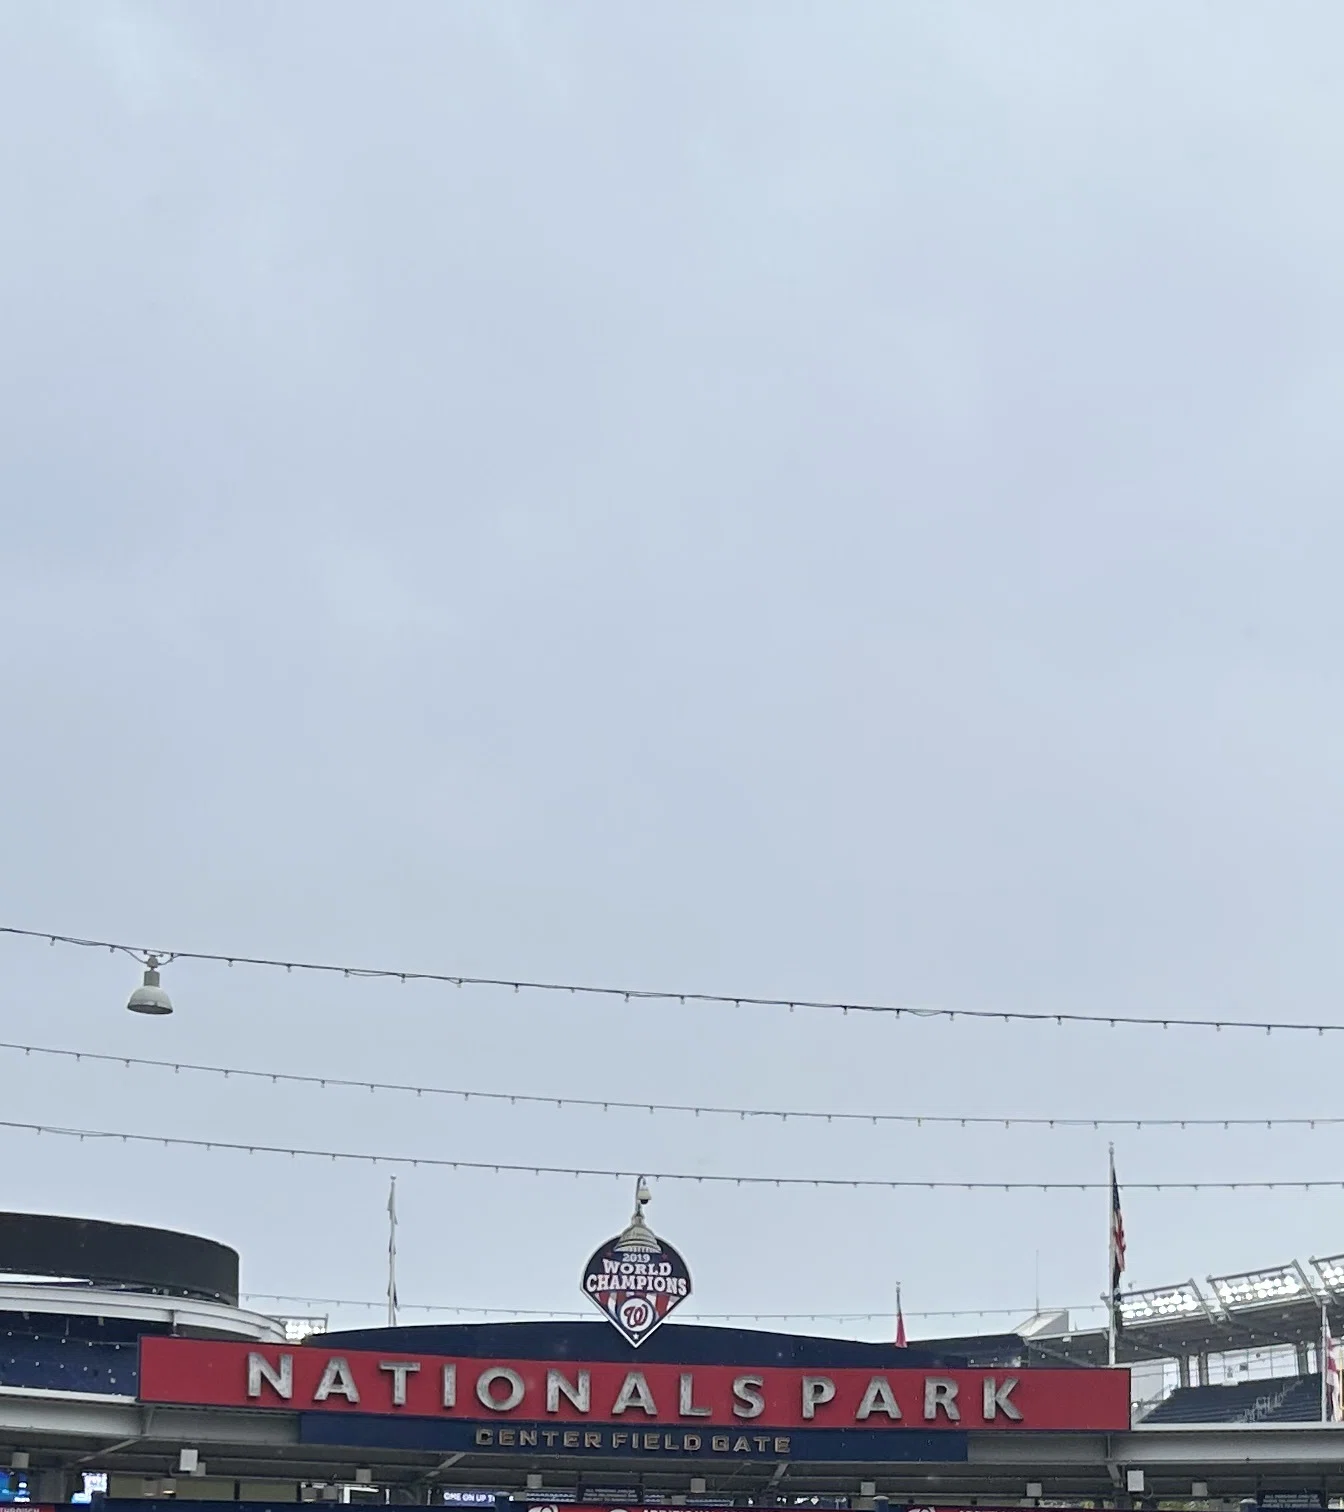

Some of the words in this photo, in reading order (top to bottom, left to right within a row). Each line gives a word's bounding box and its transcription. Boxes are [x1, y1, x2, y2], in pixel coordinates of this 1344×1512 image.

[602, 1258, 672, 1276] WORLD
[622, 1253, 651, 1263] 2019
[586, 1274, 687, 1296] CHAMPIONS
[247, 1351, 766, 1419] NATIONALS
[801, 1375, 1024, 1422] PARK
[475, 1427, 603, 1449] CENTER
[611, 1431, 702, 1452] FIELD
[712, 1434, 791, 1454] GATE
